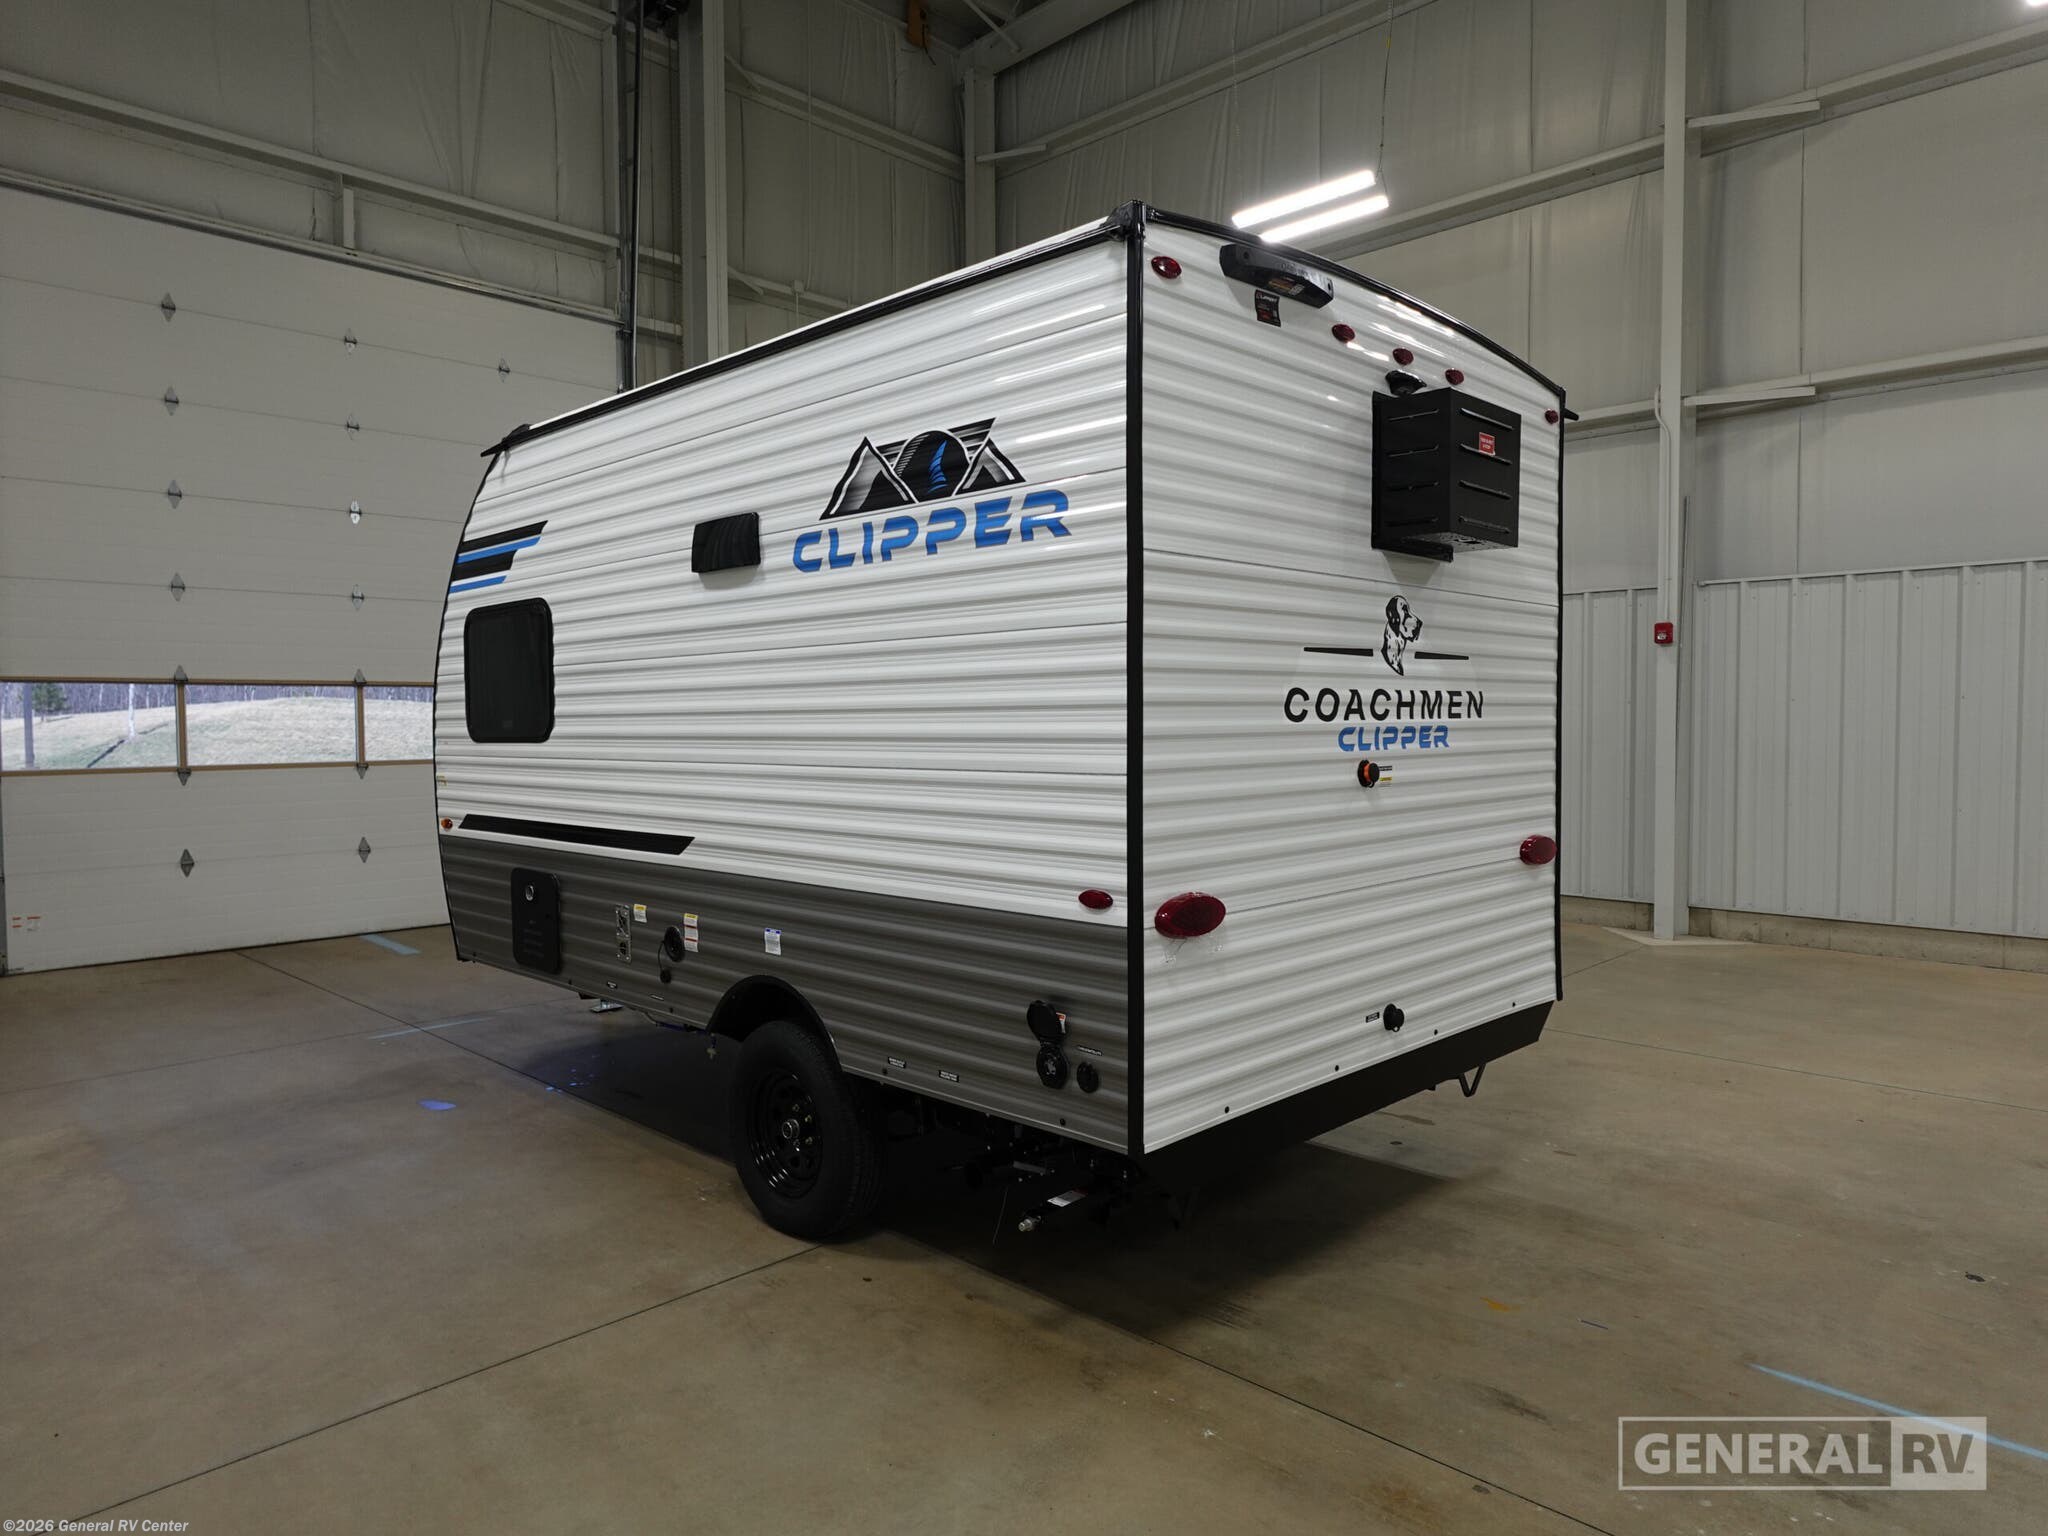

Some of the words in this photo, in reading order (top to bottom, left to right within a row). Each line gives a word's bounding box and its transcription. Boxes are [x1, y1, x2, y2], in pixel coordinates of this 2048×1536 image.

[792, 489, 1072, 573] CLIPPER
[1284, 687, 1484, 723] COACHMEN
[1338, 725, 1450, 752] CLIPPER
